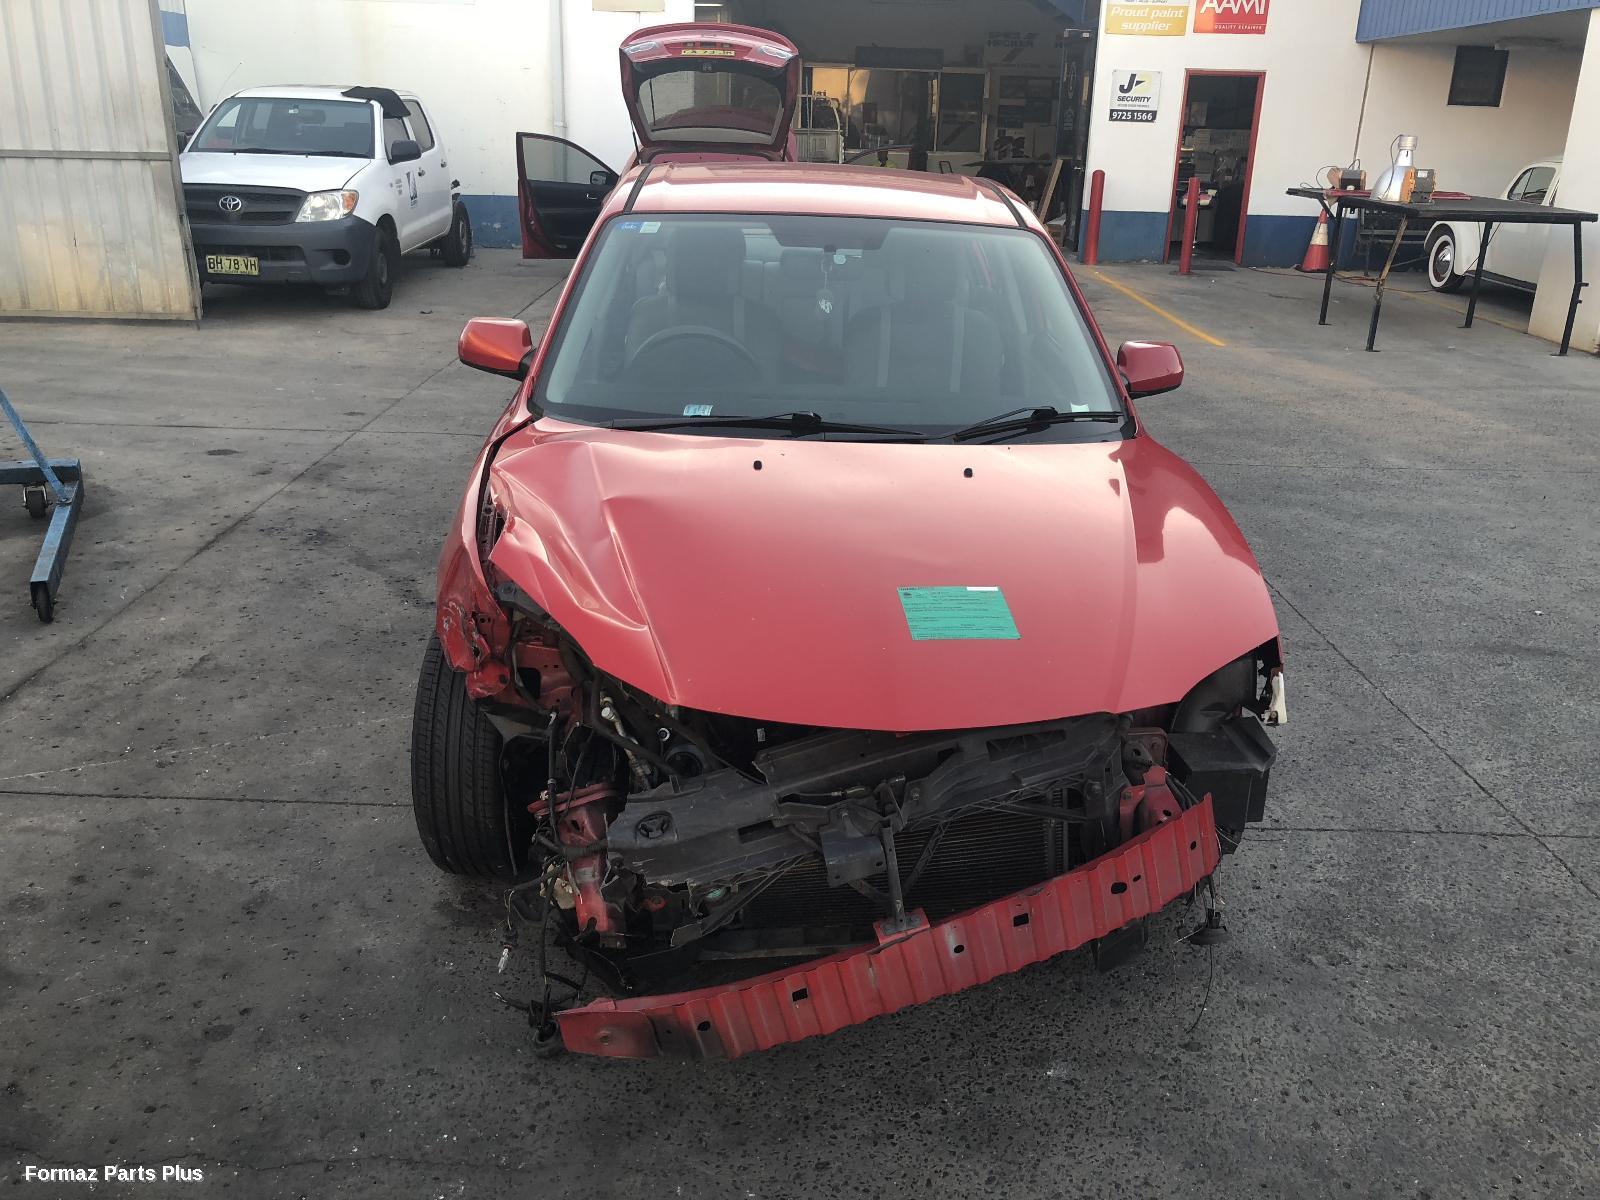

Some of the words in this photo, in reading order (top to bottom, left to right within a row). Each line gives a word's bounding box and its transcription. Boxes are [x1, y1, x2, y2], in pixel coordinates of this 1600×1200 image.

[1111, 6, 1148, 18] Proud
[1150, 7, 1184, 20] paint
[1200, 0, 1266, 15] AAMI
[1120, 21, 1172, 31] supplier
[1117, 95, 1152, 103] SECURITY
[1112, 111, 1132, 120] 9725
[1133, 112, 1153, 121] 1566
[208, 257, 223, 270] BH
[225, 258, 240, 270] 78
[243, 258, 257, 271] VH
